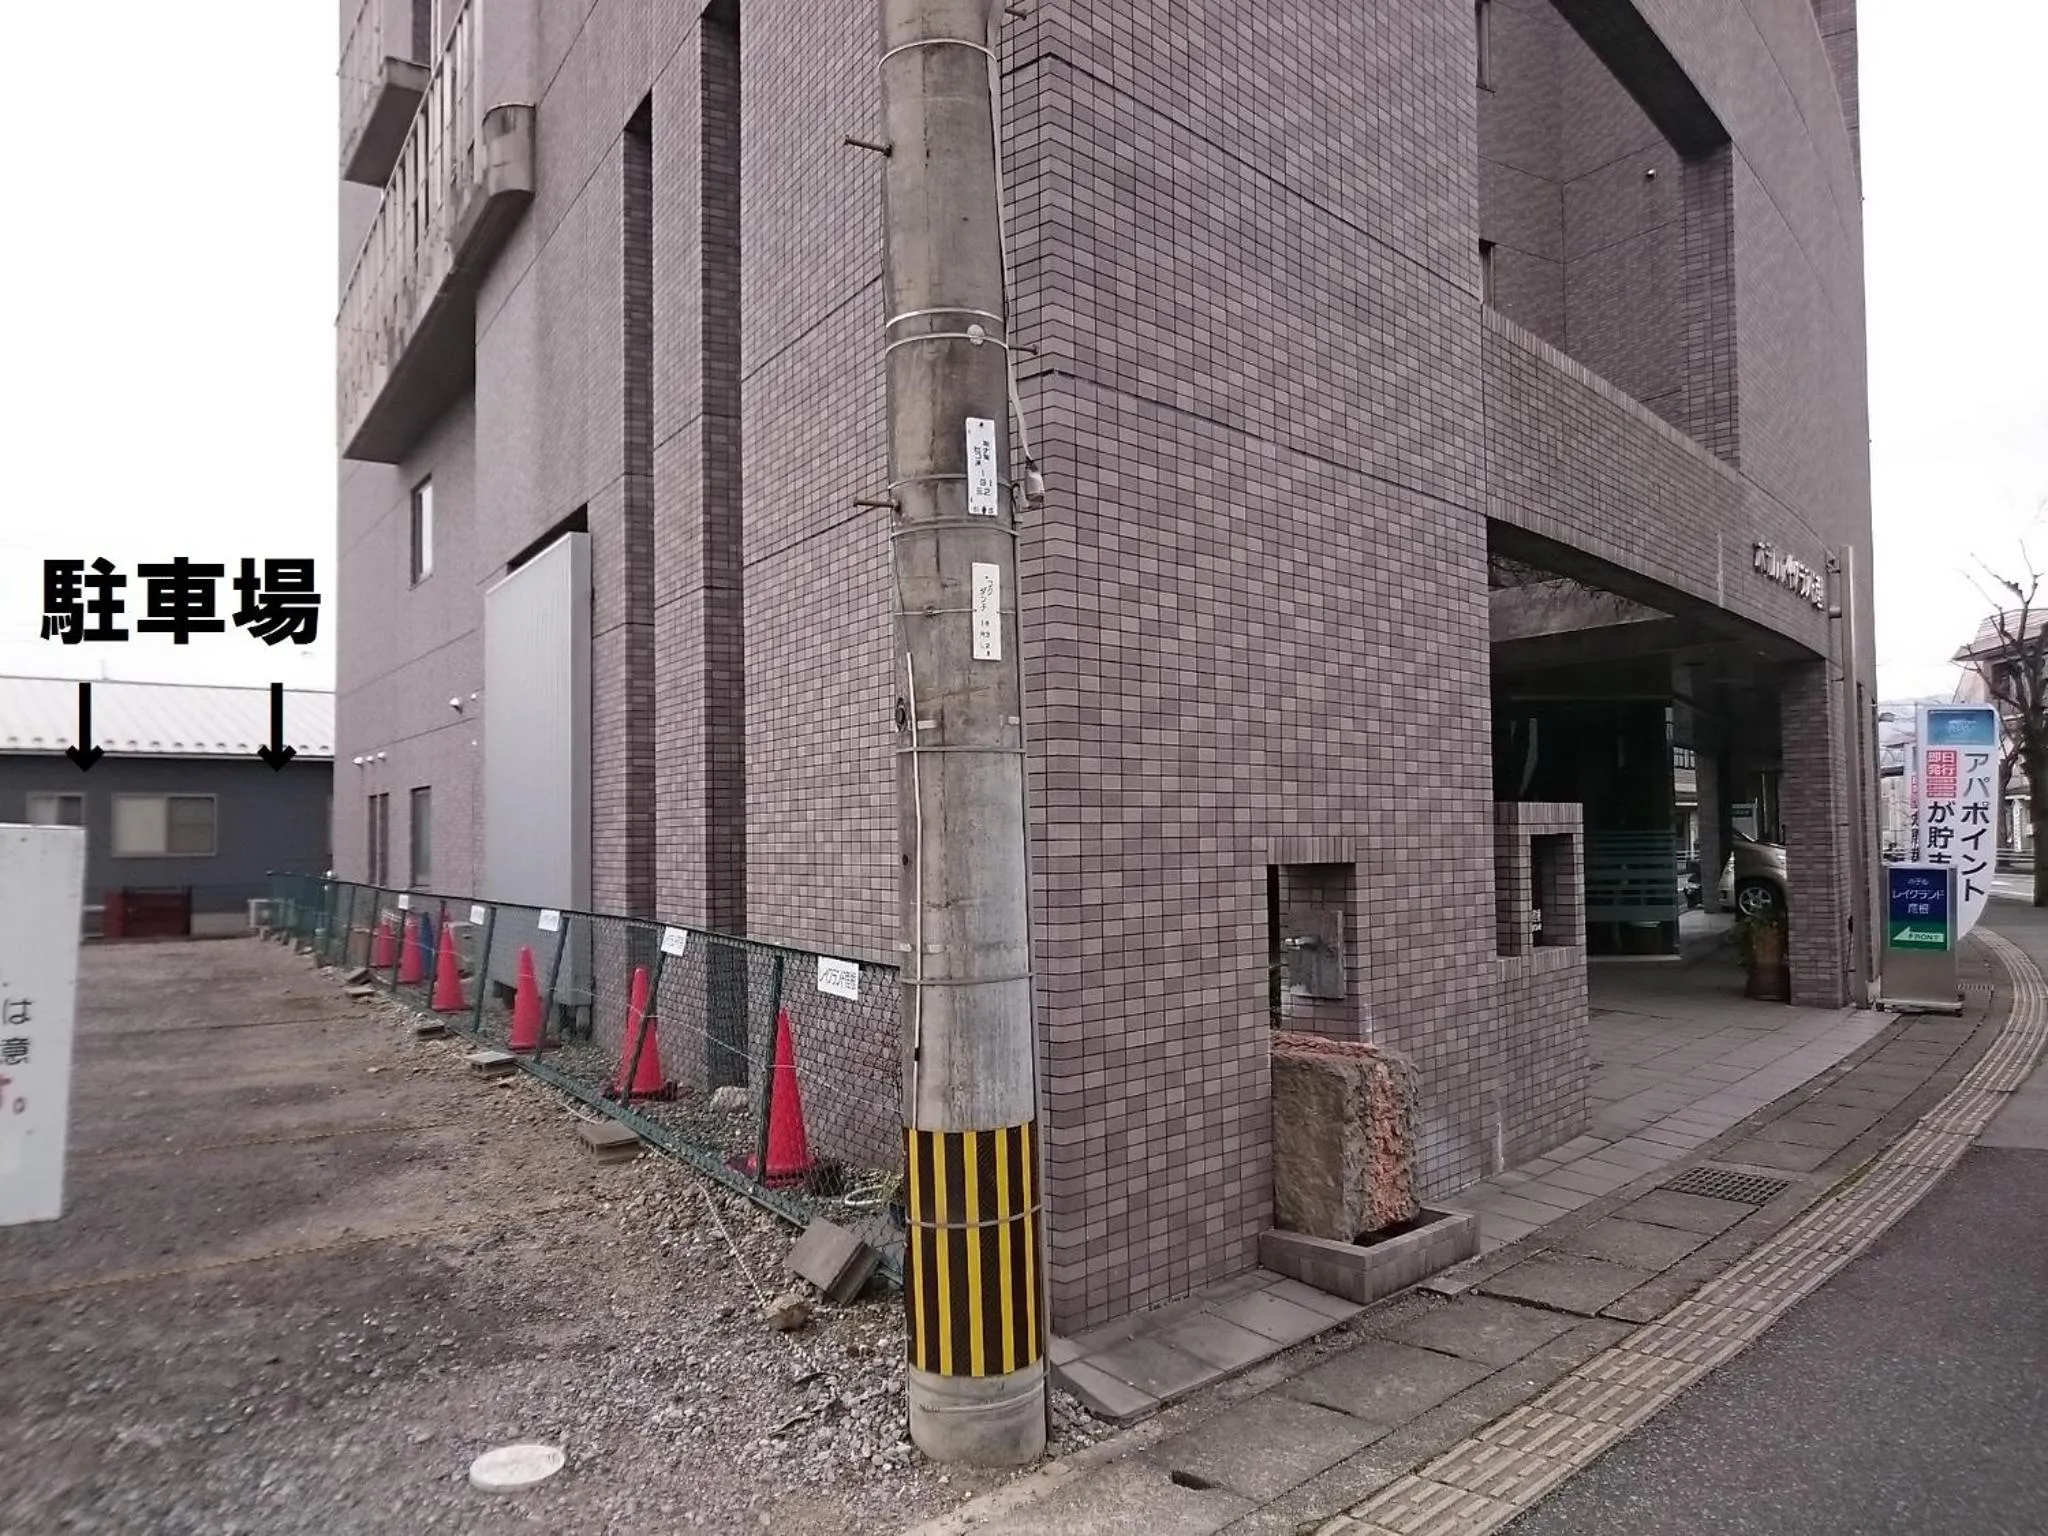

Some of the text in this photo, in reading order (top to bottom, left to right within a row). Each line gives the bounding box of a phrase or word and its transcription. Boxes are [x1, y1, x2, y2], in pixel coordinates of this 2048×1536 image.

[1928, 752, 1955, 763] 即日
[1928, 764, 1955, 777] 発行
[1961, 752, 1991, 902] アパポイント
[1892, 888, 1945, 900] レイクランド
[2, 998, 33, 1025] は
